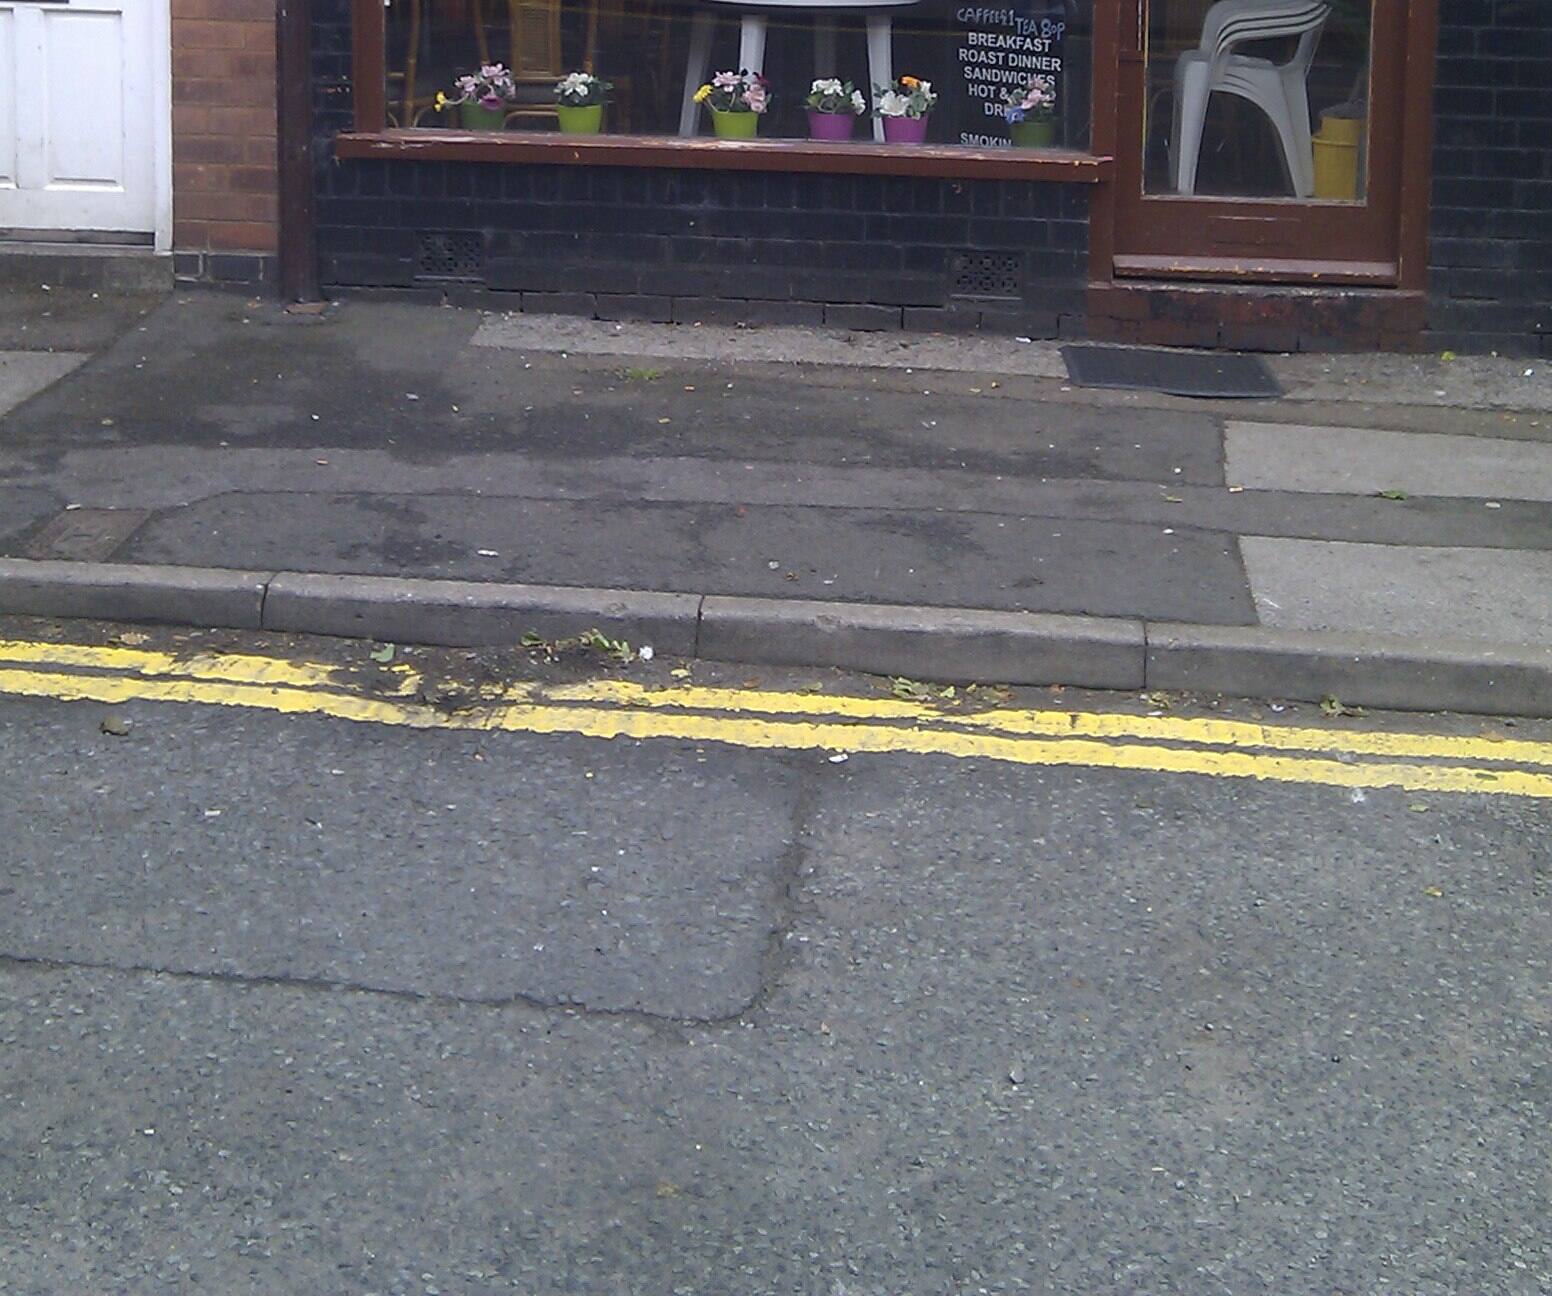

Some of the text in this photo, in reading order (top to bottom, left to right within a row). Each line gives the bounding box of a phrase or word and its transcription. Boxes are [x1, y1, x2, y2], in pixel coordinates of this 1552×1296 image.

[1015, 18, 1038, 36] TEA
[967, 31, 1052, 52] BREAKFAST
[958, 48, 1062, 72] ROAST DINNER
[968, 83, 997, 99] HOT
[1000, 86, 1009, 99] &
